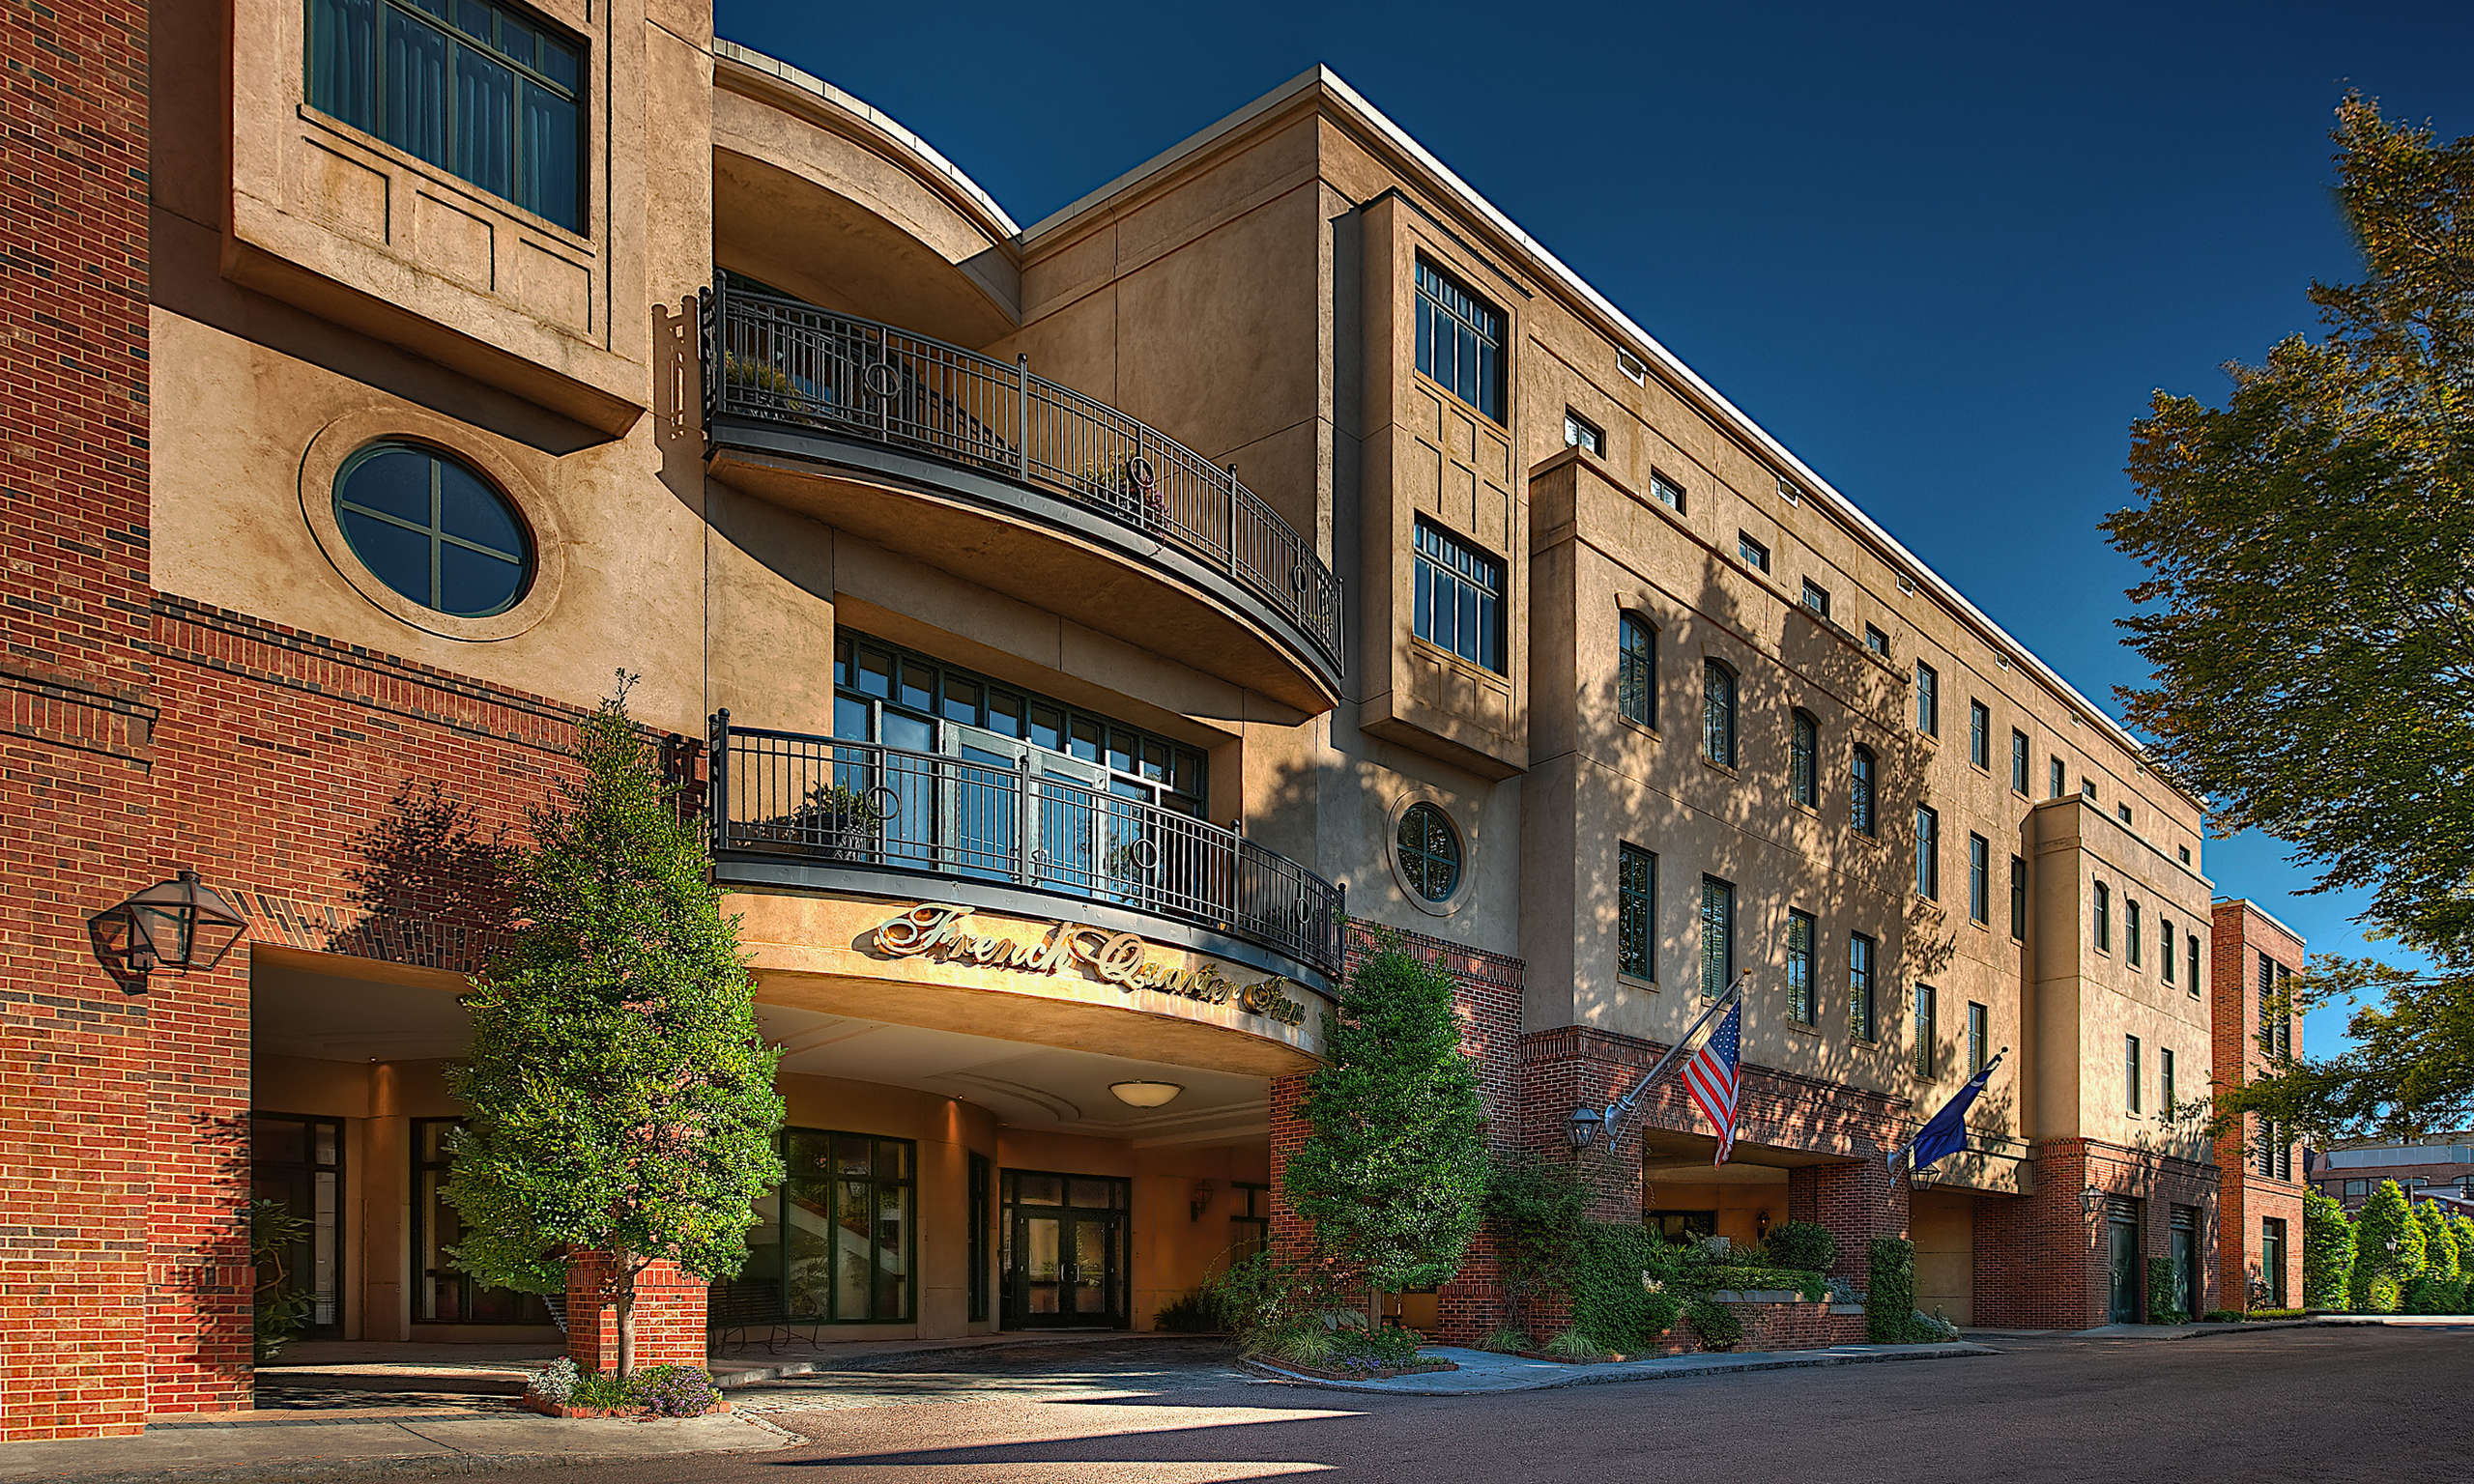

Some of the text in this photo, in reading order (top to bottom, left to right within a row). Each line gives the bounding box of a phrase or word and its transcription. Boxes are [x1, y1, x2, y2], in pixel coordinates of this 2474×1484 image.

[876, 902, 1307, 1025] French Quarter Inn
